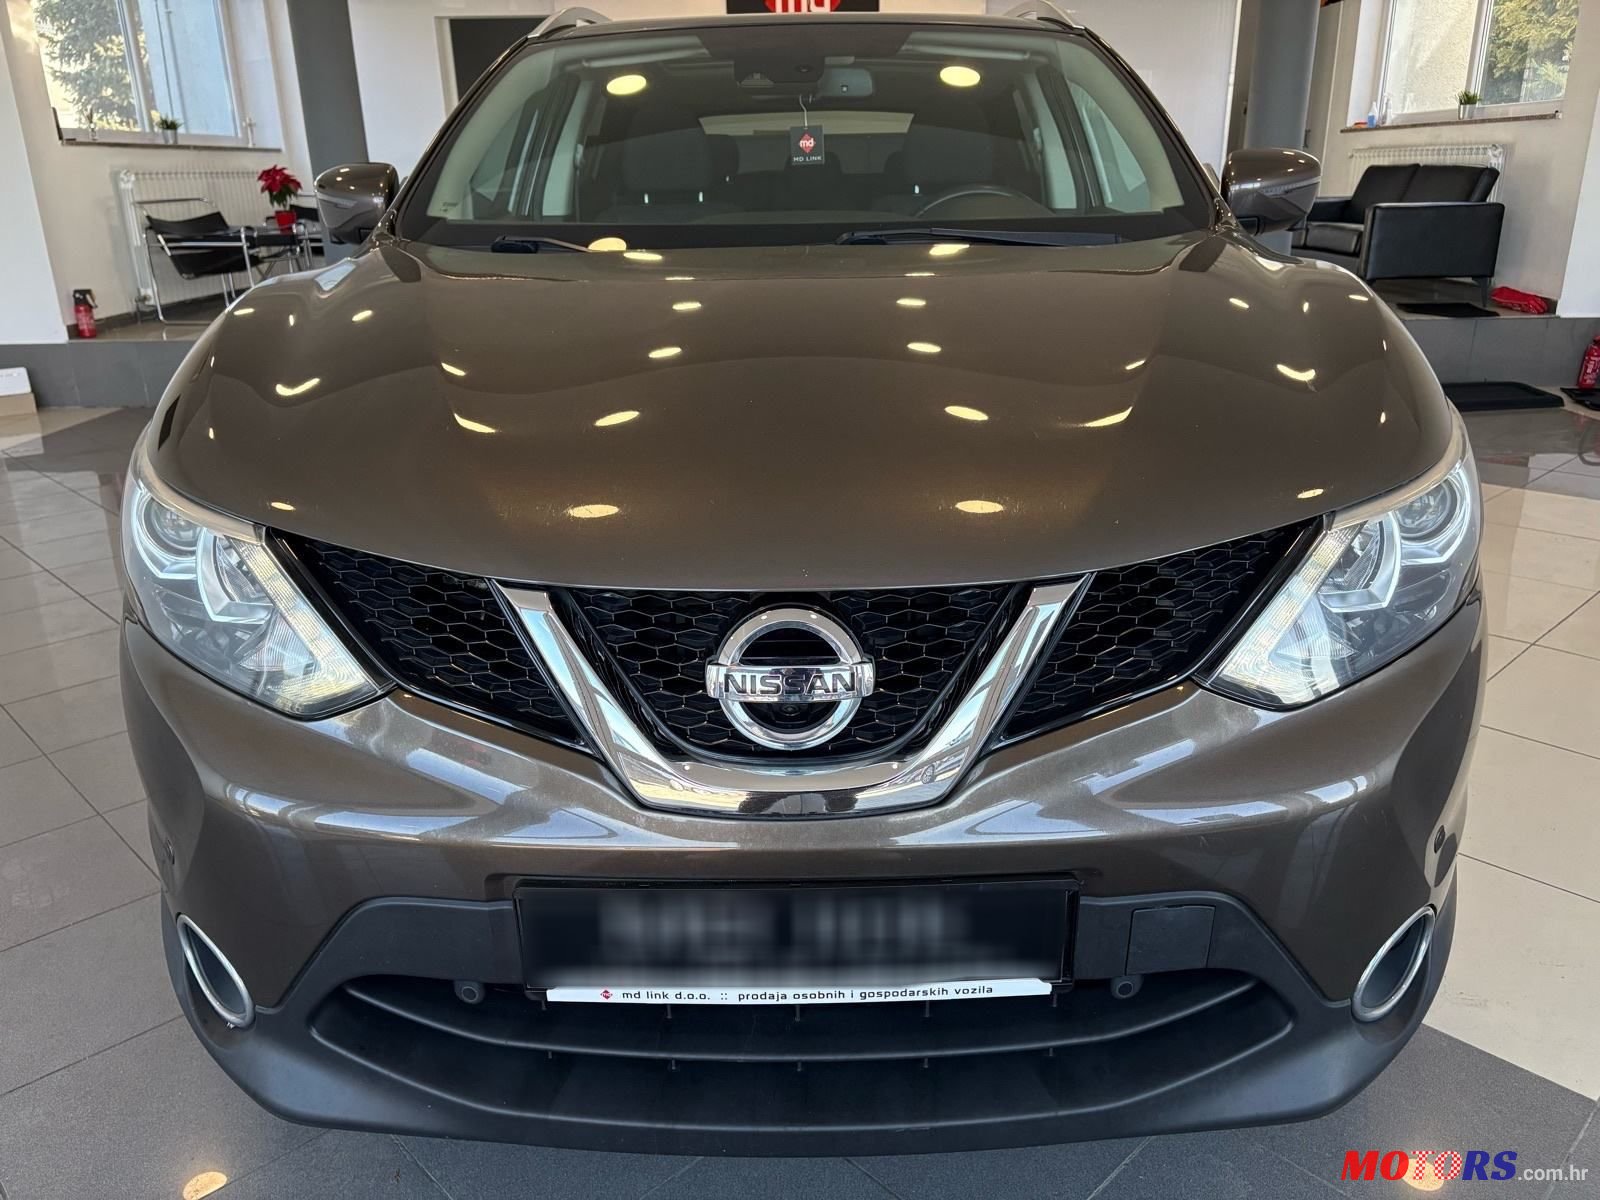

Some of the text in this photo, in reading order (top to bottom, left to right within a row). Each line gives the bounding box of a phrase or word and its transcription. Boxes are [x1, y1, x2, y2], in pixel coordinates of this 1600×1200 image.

[799, 137, 814, 148] md
[723, 672, 856, 695] NISSAN
[622, 990, 641, 999] md
[646, 990, 670, 1000] link
[674, 990, 711, 1001] d.o.o.
[738, 991, 788, 1002] prodaja
[792, 990, 845, 1000] osobnih
[859, 988, 949, 1000] gospodarskih
[954, 985, 993, 995] vozila
